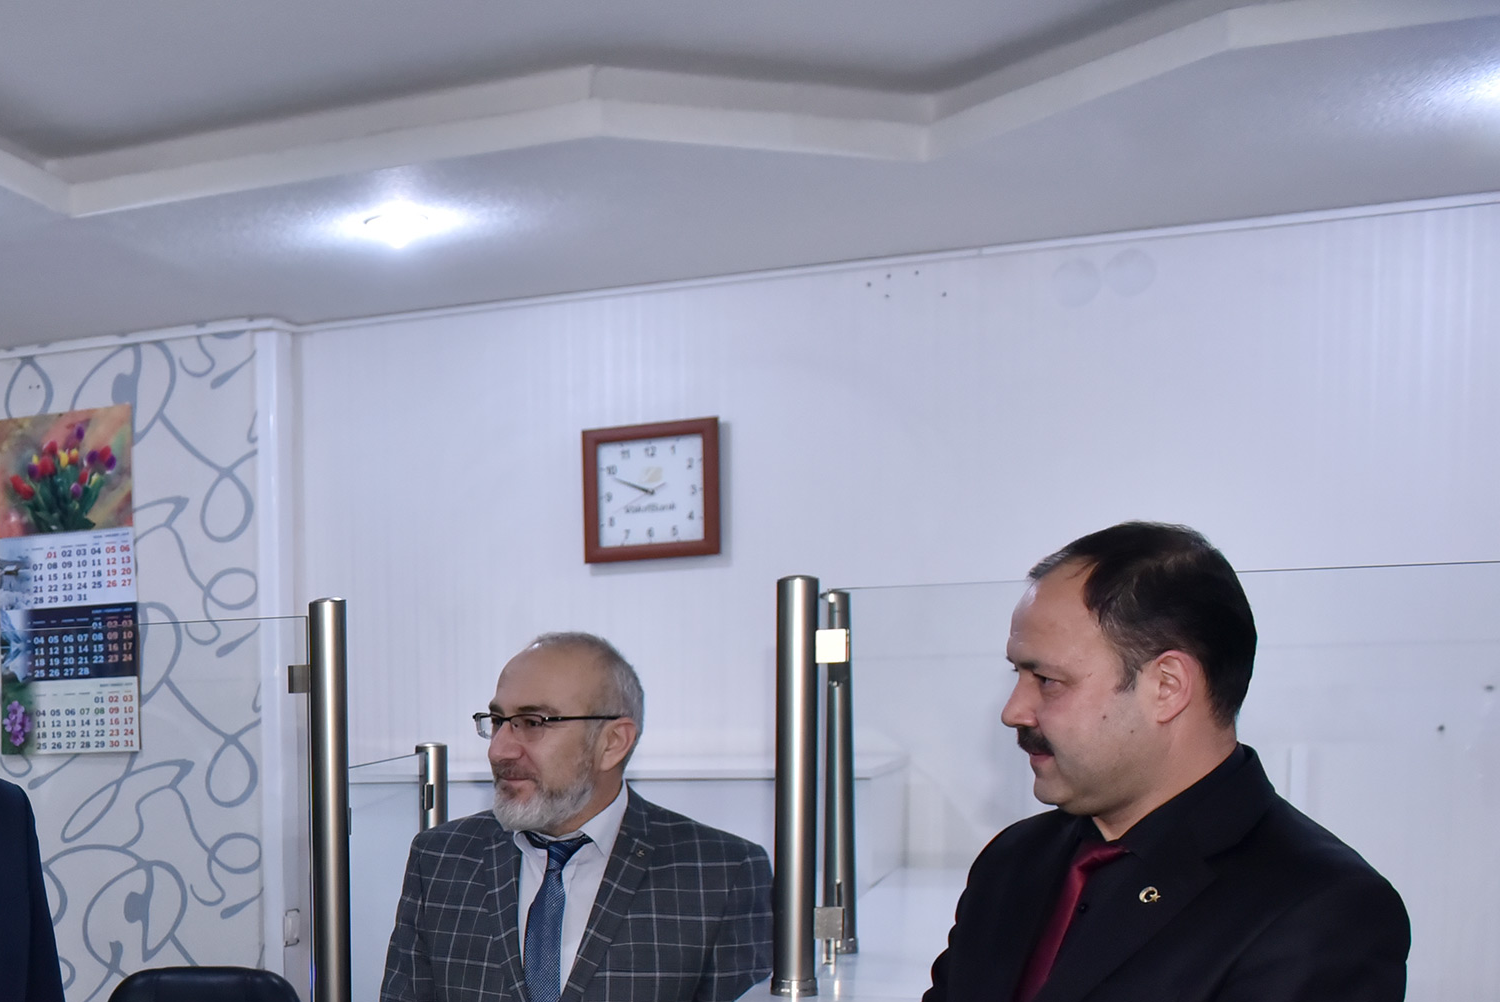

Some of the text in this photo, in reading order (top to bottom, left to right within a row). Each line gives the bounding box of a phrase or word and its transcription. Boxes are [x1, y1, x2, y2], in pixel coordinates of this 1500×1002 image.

[621, 449, 630, 459] 11
[644, 446, 657, 457] 12
[671, 445, 676, 455] 1
[687, 458, 694, 469] 2
[606, 465, 618, 475] 10
[691, 484, 697, 496] 3
[605, 492, 613, 503] 9
[609, 516, 615, 527] 8
[687, 511, 694, 521] 4
[624, 529, 631, 539] 7
[647, 527, 655, 538] 6
[672, 525, 679, 537] 5
[76, 548, 86, 556] 03
[106, 546, 116, 554] 05
[33, 563, 43, 571] 07
[47, 562, 58, 570] 08
[78, 560, 87, 568] 10
[122, 556, 130, 564] 13
[63, 572, 72, 580] 16
[48, 584, 58, 592] 22
[77, 582, 87, 590] 24
[107, 580, 117, 588] 26
[63, 594, 73, 602] 30
[62, 635, 74, 643] 06
[77, 634, 88, 642] 07
[92, 633, 103, 641] 08
[107, 632, 118, 640] 09
[123, 631, 133, 639] 10
[64, 646, 74, 654] 13
[79, 645, 88, 653] 14
[94, 644, 104, 652] 15
[123, 642, 132, 650] 17
[35, 658, 45, 666] 18
[50, 658, 60, 666] 19
[78, 656, 88, 664] 21
[108, 654, 118, 663] 23
[49, 669, 60, 677] 26
[64, 668, 74, 676] 27
[78, 667, 90, 675] 28
[36, 709, 46, 717] 04
[124, 706, 133, 714] 10
[37, 720, 46, 728] 11
[52, 720, 61, 728] 12
[96, 718, 105, 726] 15
[37, 742, 47, 750] 25
[110, 740, 120, 748] 30
